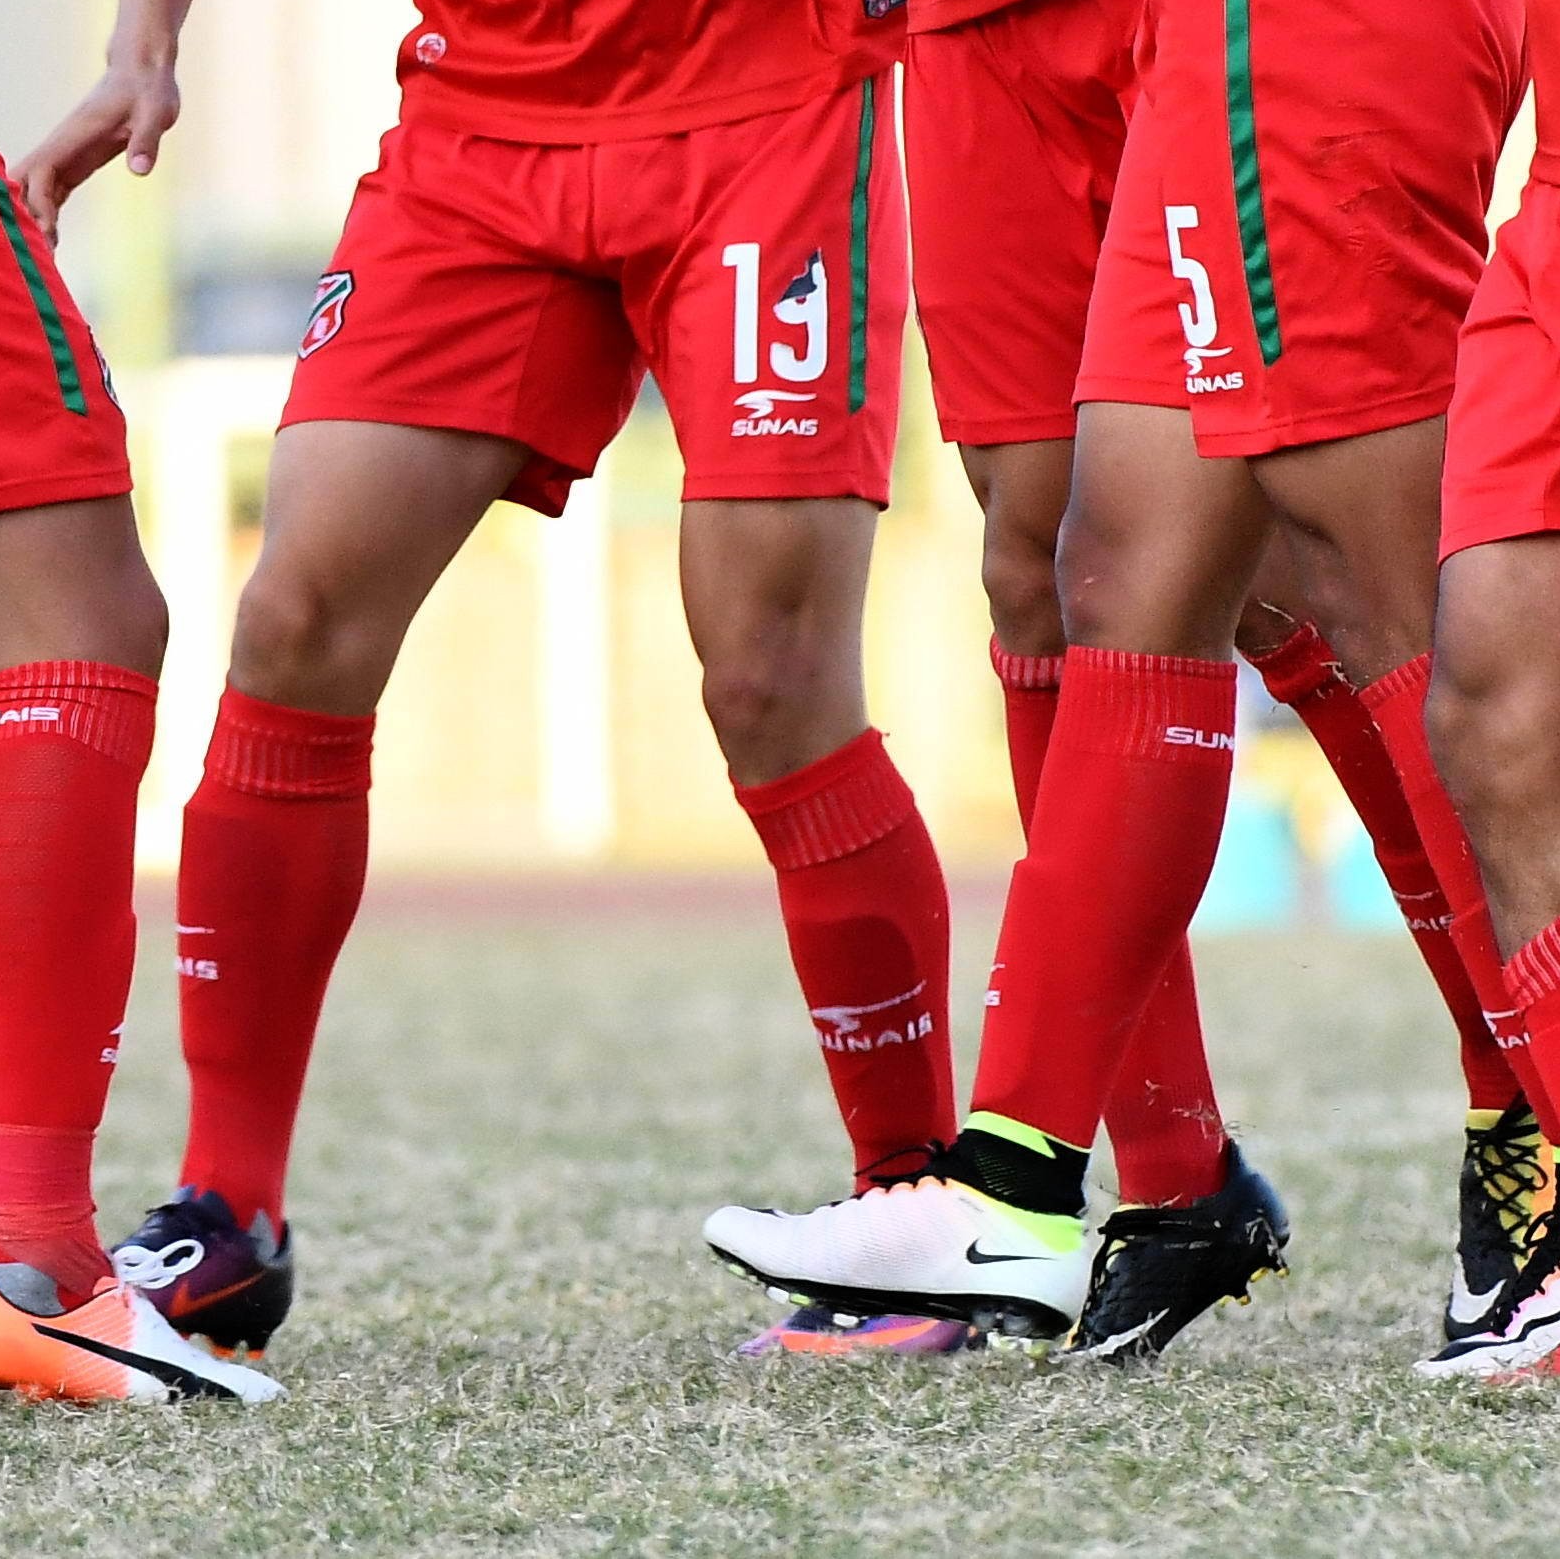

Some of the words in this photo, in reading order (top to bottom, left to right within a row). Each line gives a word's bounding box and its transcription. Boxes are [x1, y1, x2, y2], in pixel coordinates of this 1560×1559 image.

[1164, 205, 1217, 348] 5
[731, 417, 818, 437] SUNAIS
[815, 1011, 933, 1052] UNAIS
